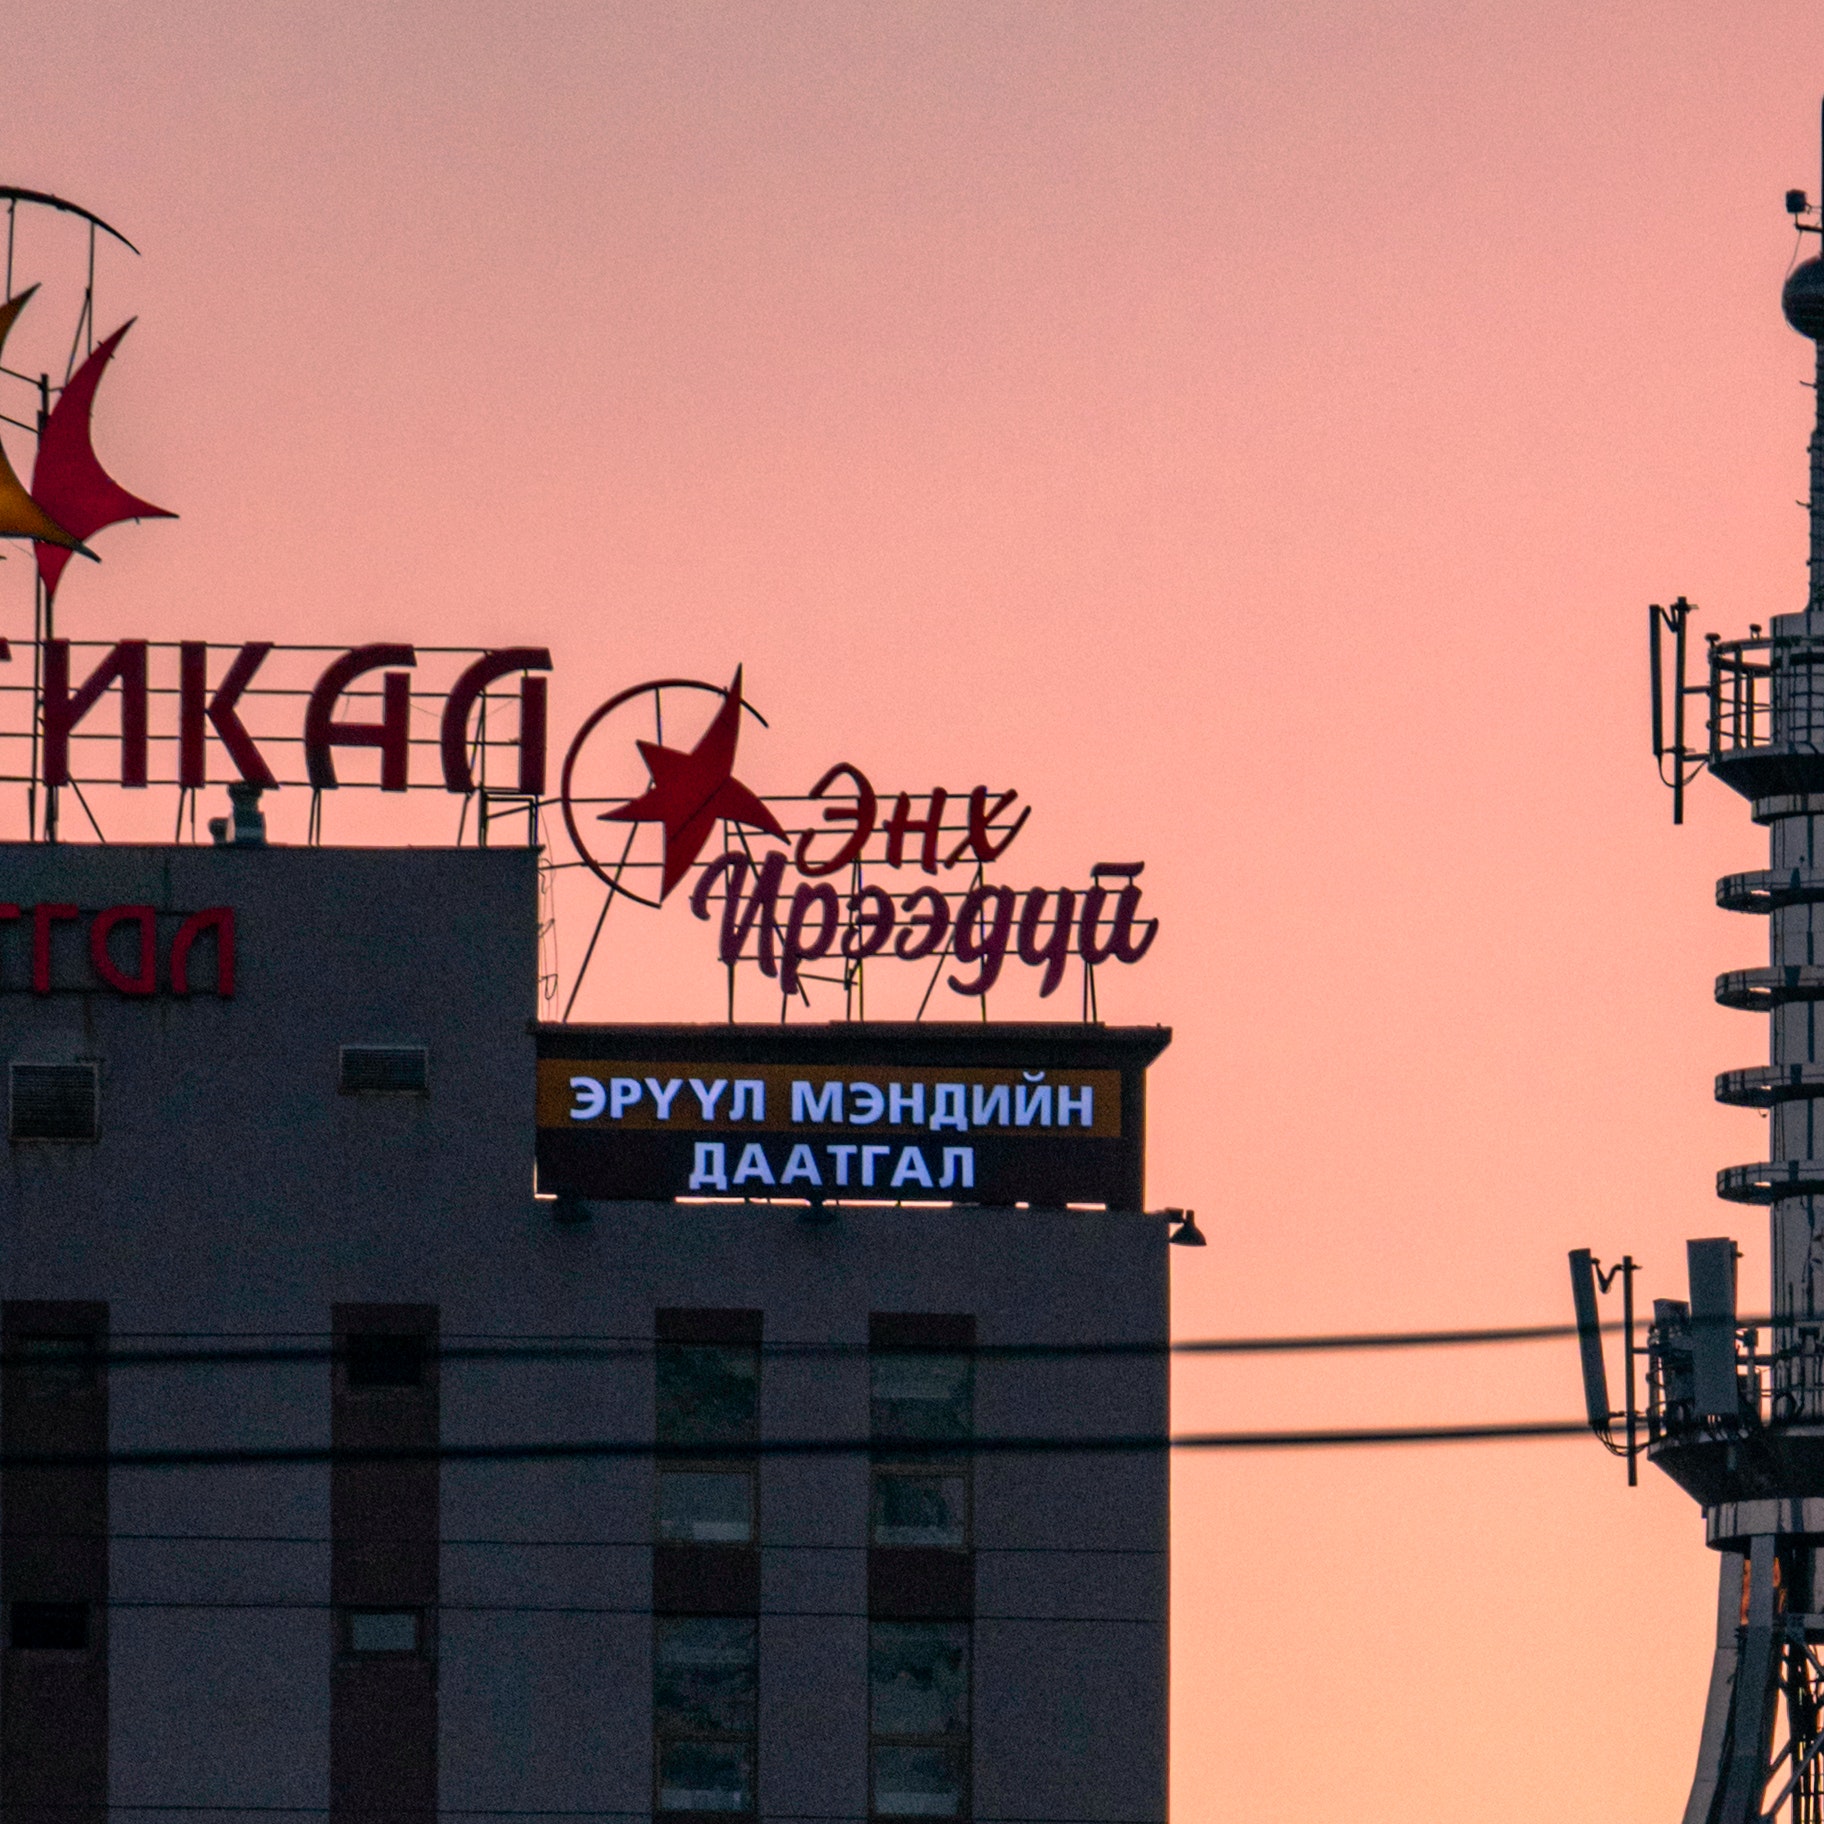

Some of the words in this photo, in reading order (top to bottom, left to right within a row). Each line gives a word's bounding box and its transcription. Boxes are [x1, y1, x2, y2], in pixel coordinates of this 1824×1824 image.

[0, 638, 553, 794] ИКАЛ
[795, 762, 1032, 878] Энх
[568, 1076, 766, 1123] ЭРҮҮЛ
[789, 1072, 1095, 1130] МЭНДИЙН
[688, 1142, 977, 1192] ДААТГАЛ
